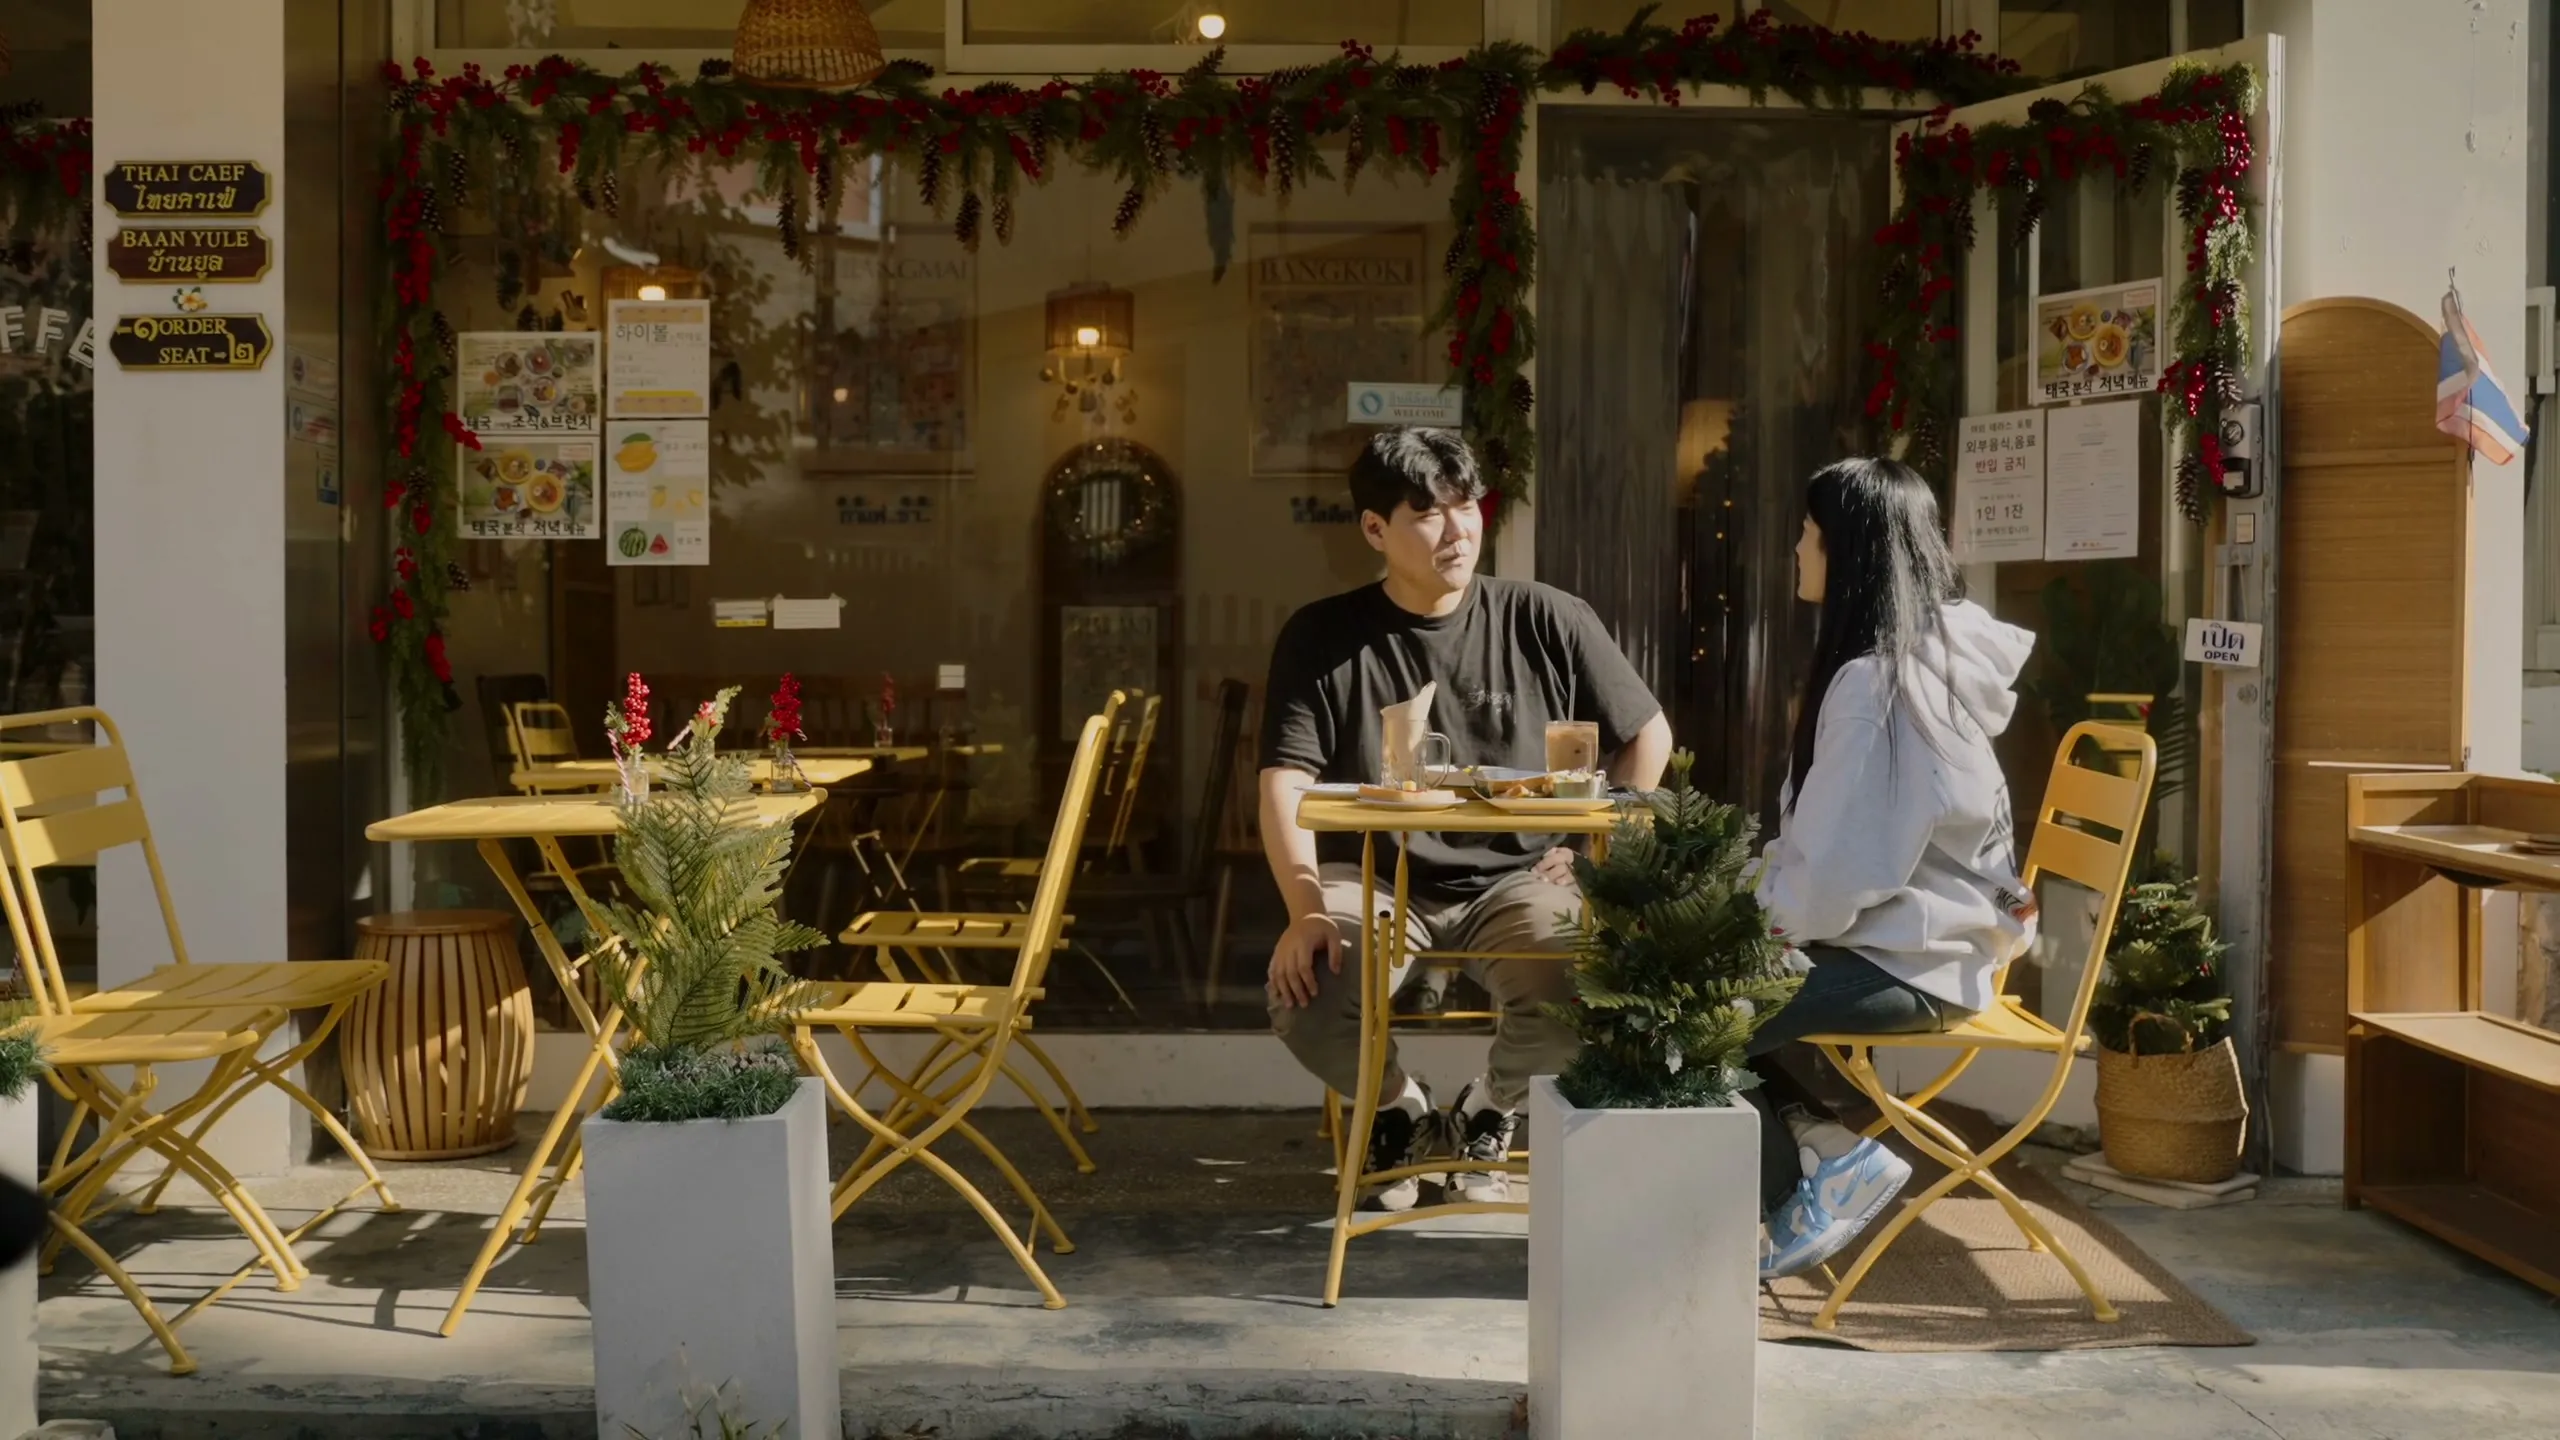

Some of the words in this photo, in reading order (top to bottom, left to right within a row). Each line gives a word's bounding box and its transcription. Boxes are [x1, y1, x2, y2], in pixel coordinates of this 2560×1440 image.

[122, 165, 180, 182] THAI
[188, 165, 245, 182] CAEF
[122, 231, 185, 248] BAAN
[191, 231, 249, 248] YULE
[159, 319, 229, 336] ORDER
[616, 323, 668, 343] 하이볼
[159, 347, 211, 364] SEAT
[2045, 380, 2070, 399] 태국
[2099, 374, 2125, 392] 저녁
[2127, 373, 2149, 389] 메뉴
[1394, 408, 1446, 419] WELCOME
[466, 415, 492, 430] 태국
[512, 415, 592, 430] 조식&브런치
[1975, 458, 1998, 474] 반입
[2004, 455, 2026, 472] 금지
[1977, 505, 1996, 521] 1인
[2004, 503, 2024, 519] 1잔
[472, 520, 499, 536] 태국
[534, 520, 560, 536] 저녁
[2202, 622, 2245, 650] เปิด
[2204, 650, 2240, 662] OPEN
